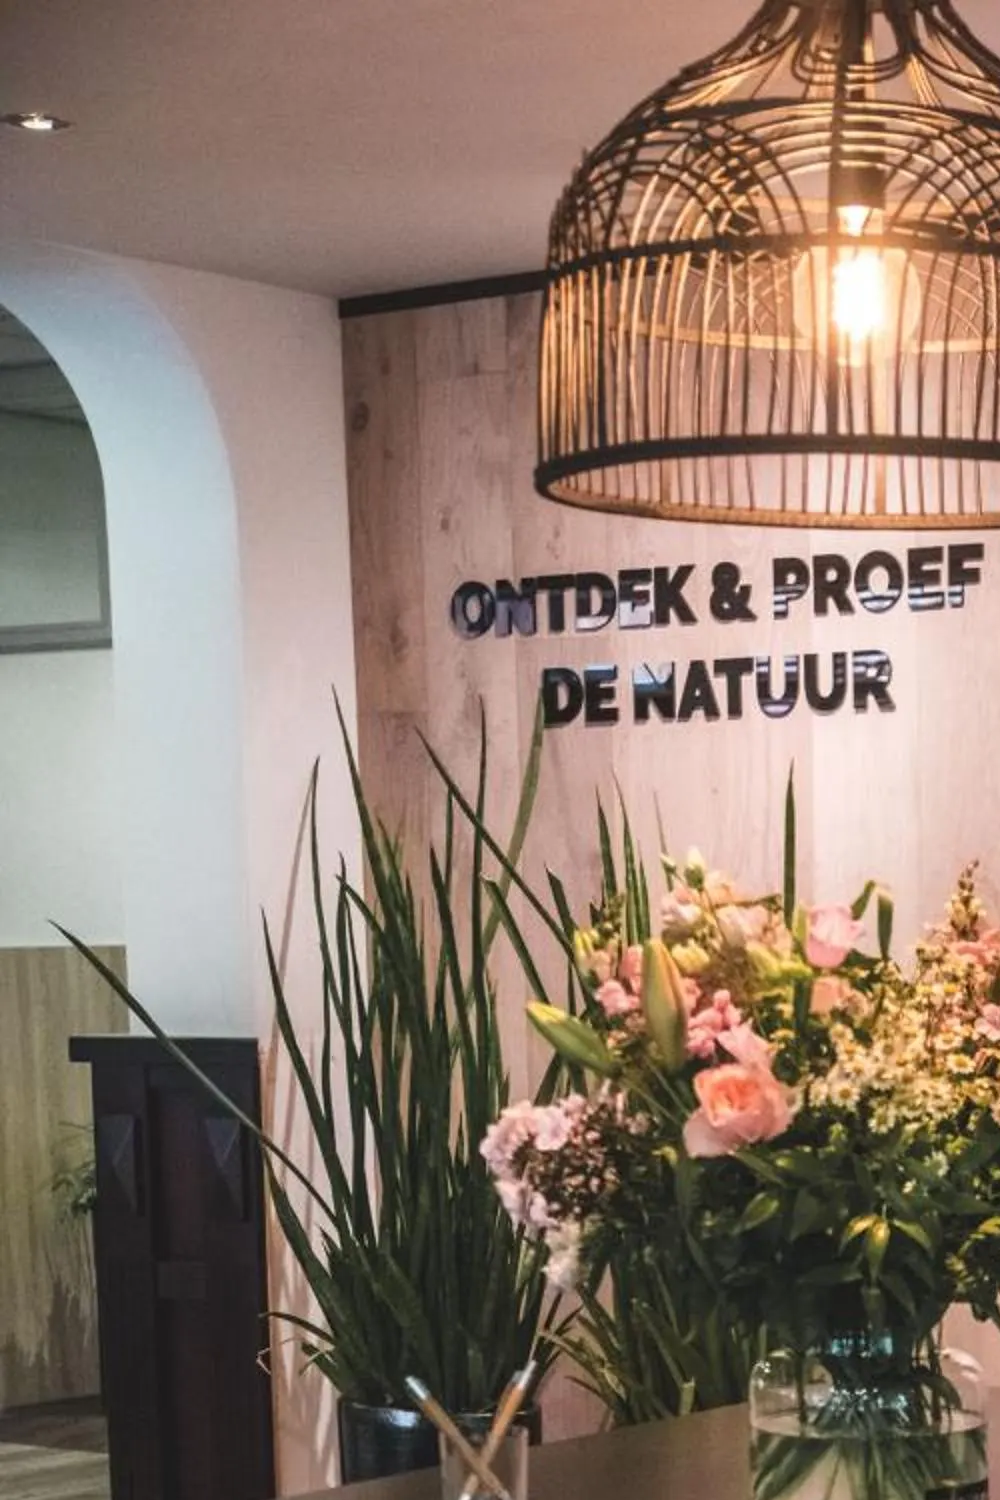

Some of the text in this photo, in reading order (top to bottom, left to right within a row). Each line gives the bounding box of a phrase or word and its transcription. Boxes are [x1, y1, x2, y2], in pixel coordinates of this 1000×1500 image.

[450, 543, 984, 640] ONTDEK & PROEF
[542, 649, 896, 728] DE NATUUR
